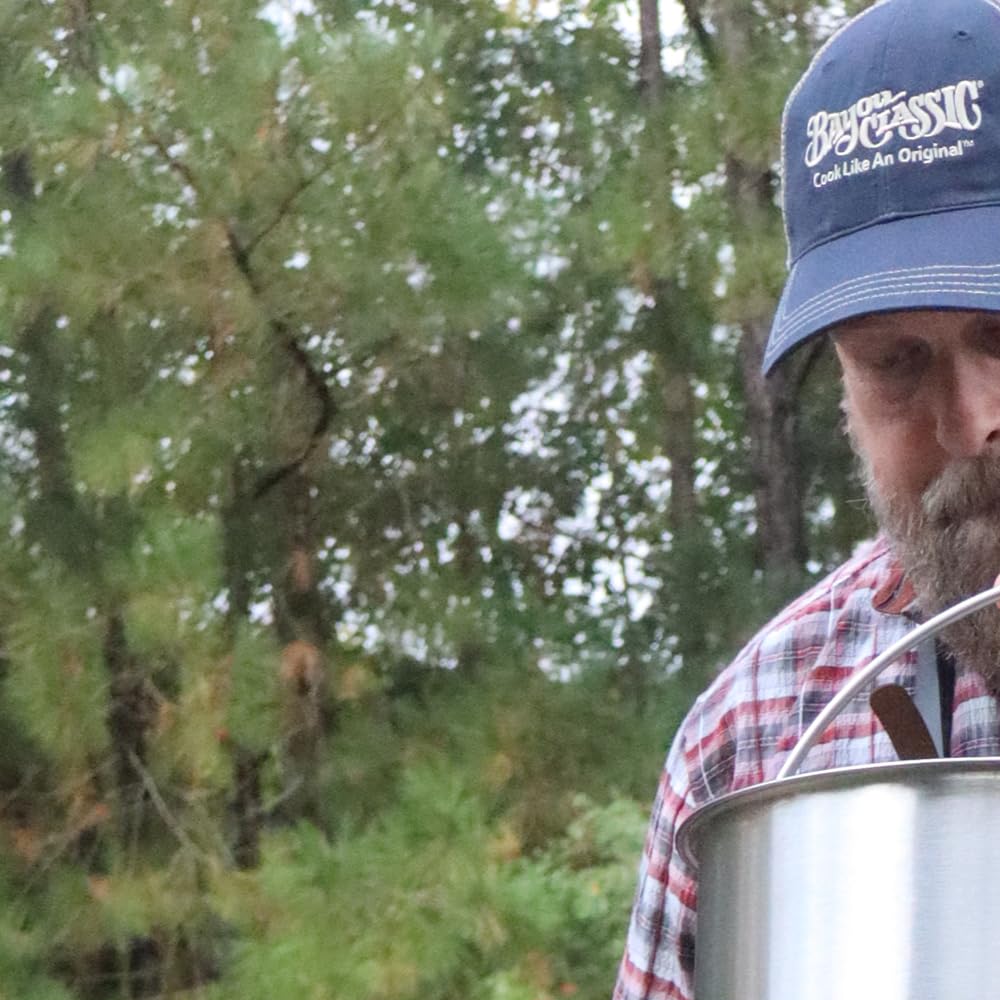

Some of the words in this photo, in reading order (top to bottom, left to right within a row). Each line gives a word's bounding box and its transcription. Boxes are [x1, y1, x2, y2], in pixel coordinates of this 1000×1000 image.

[860, 80, 982, 148] CLASSIC
[813, 164, 842, 187] Cook
[843, 158, 870, 176] Like
[872, 152, 894, 169] An
